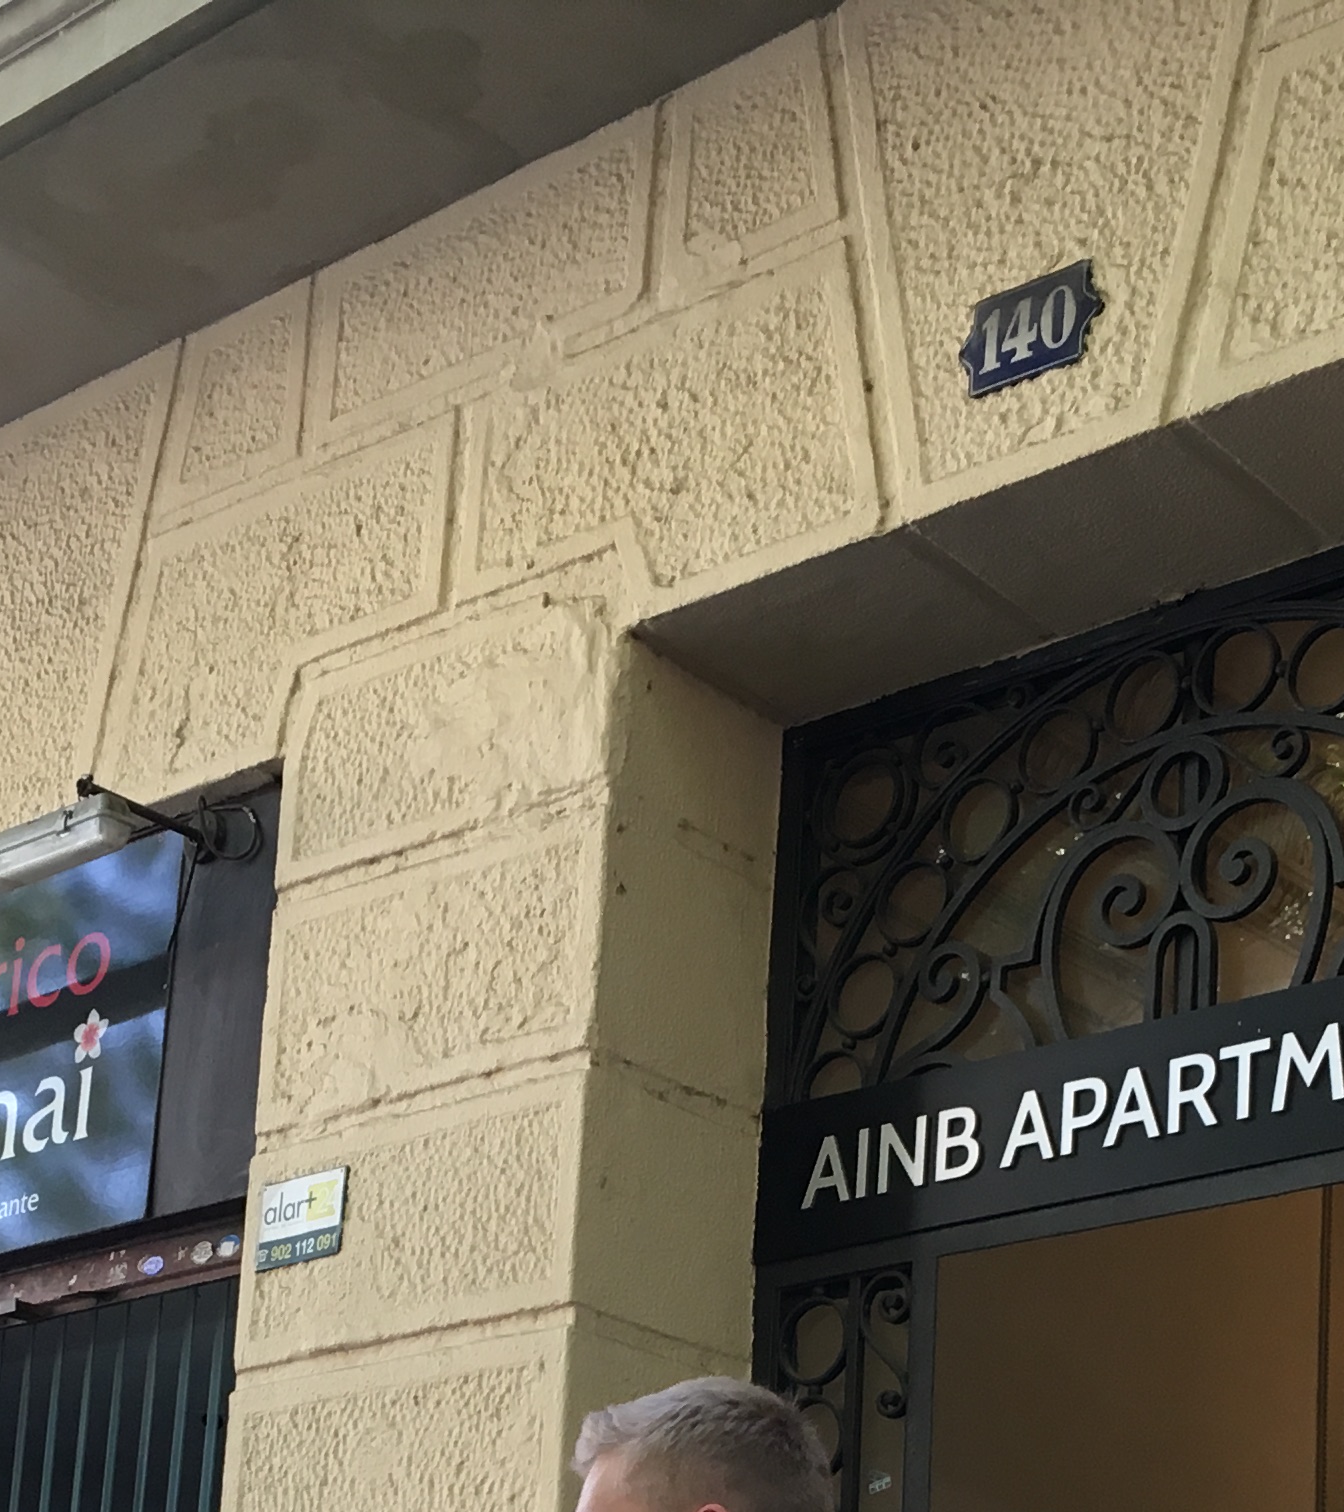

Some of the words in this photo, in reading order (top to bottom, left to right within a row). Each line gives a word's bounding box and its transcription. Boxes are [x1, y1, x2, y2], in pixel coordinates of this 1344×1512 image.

[978, 285, 1077, 375] 140
[800, 1105, 980, 1210] AINB
[270, 1243, 292, 1261] 902
[295, 1237, 315, 1256] 112
[316, 1232, 337, 1251] 091
